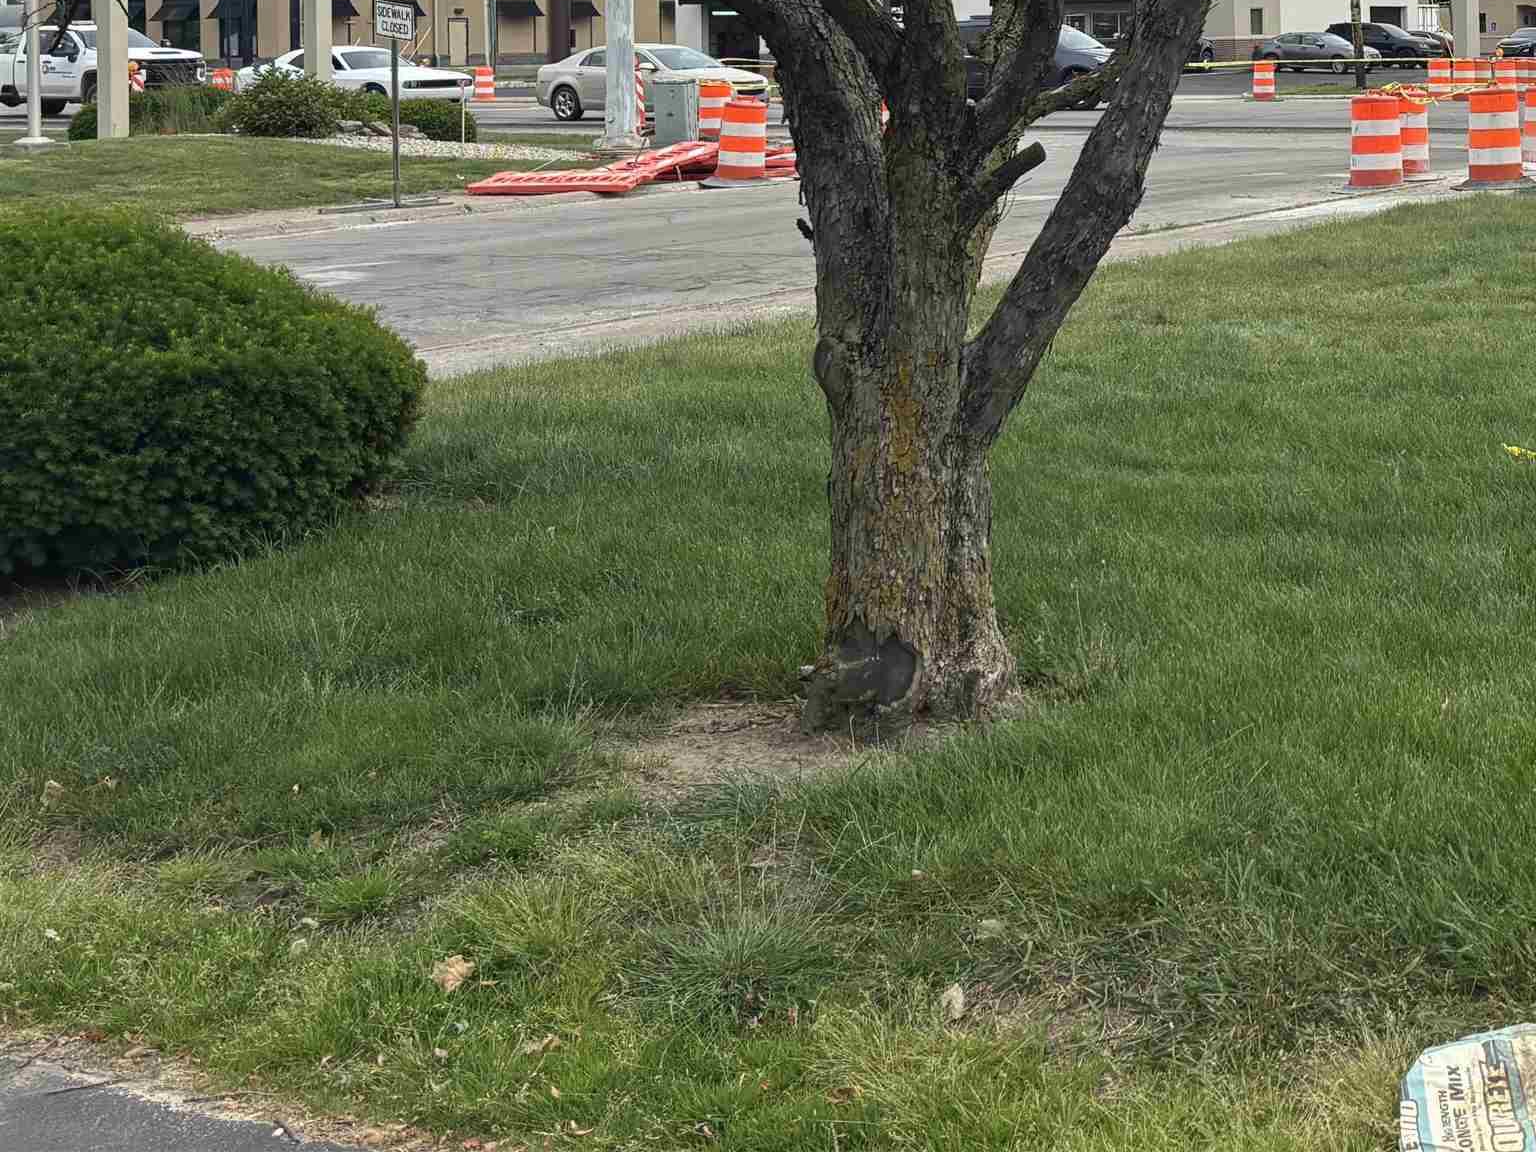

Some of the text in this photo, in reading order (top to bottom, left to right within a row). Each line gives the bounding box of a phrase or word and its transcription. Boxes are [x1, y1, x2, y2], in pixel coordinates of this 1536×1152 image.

[377, 5, 411, 23] SIDEWALK
[382, 21, 409, 35] CLOSED
[1447, 1064, 1466, 1102] MIX
